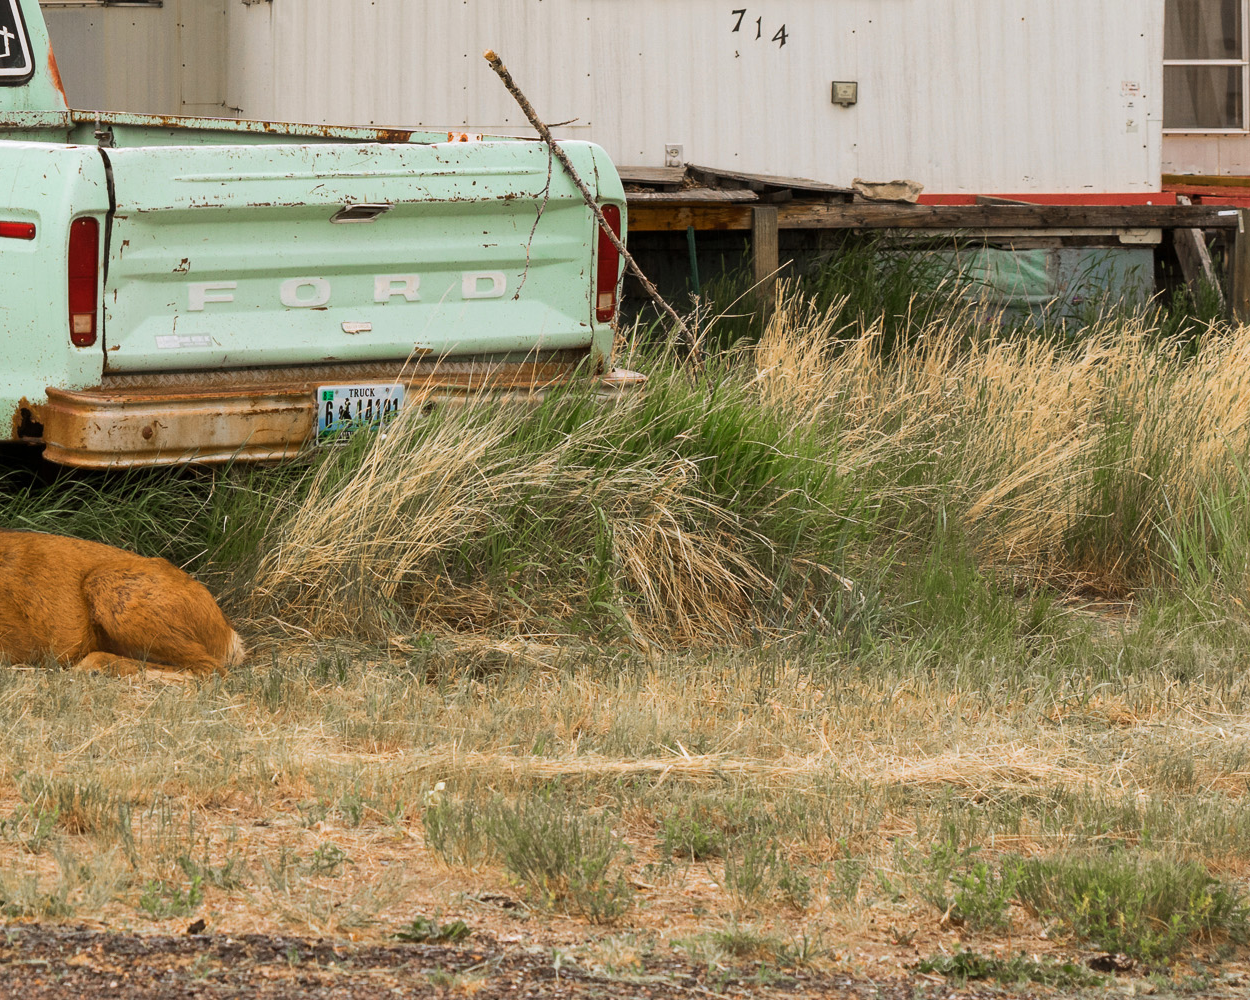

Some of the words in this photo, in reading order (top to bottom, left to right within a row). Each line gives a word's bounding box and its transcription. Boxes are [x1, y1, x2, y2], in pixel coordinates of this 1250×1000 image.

[731, 8, 789, 49] 714
[186, 271, 507, 311] FORD
[349, 388, 376, 398] TRUCK
